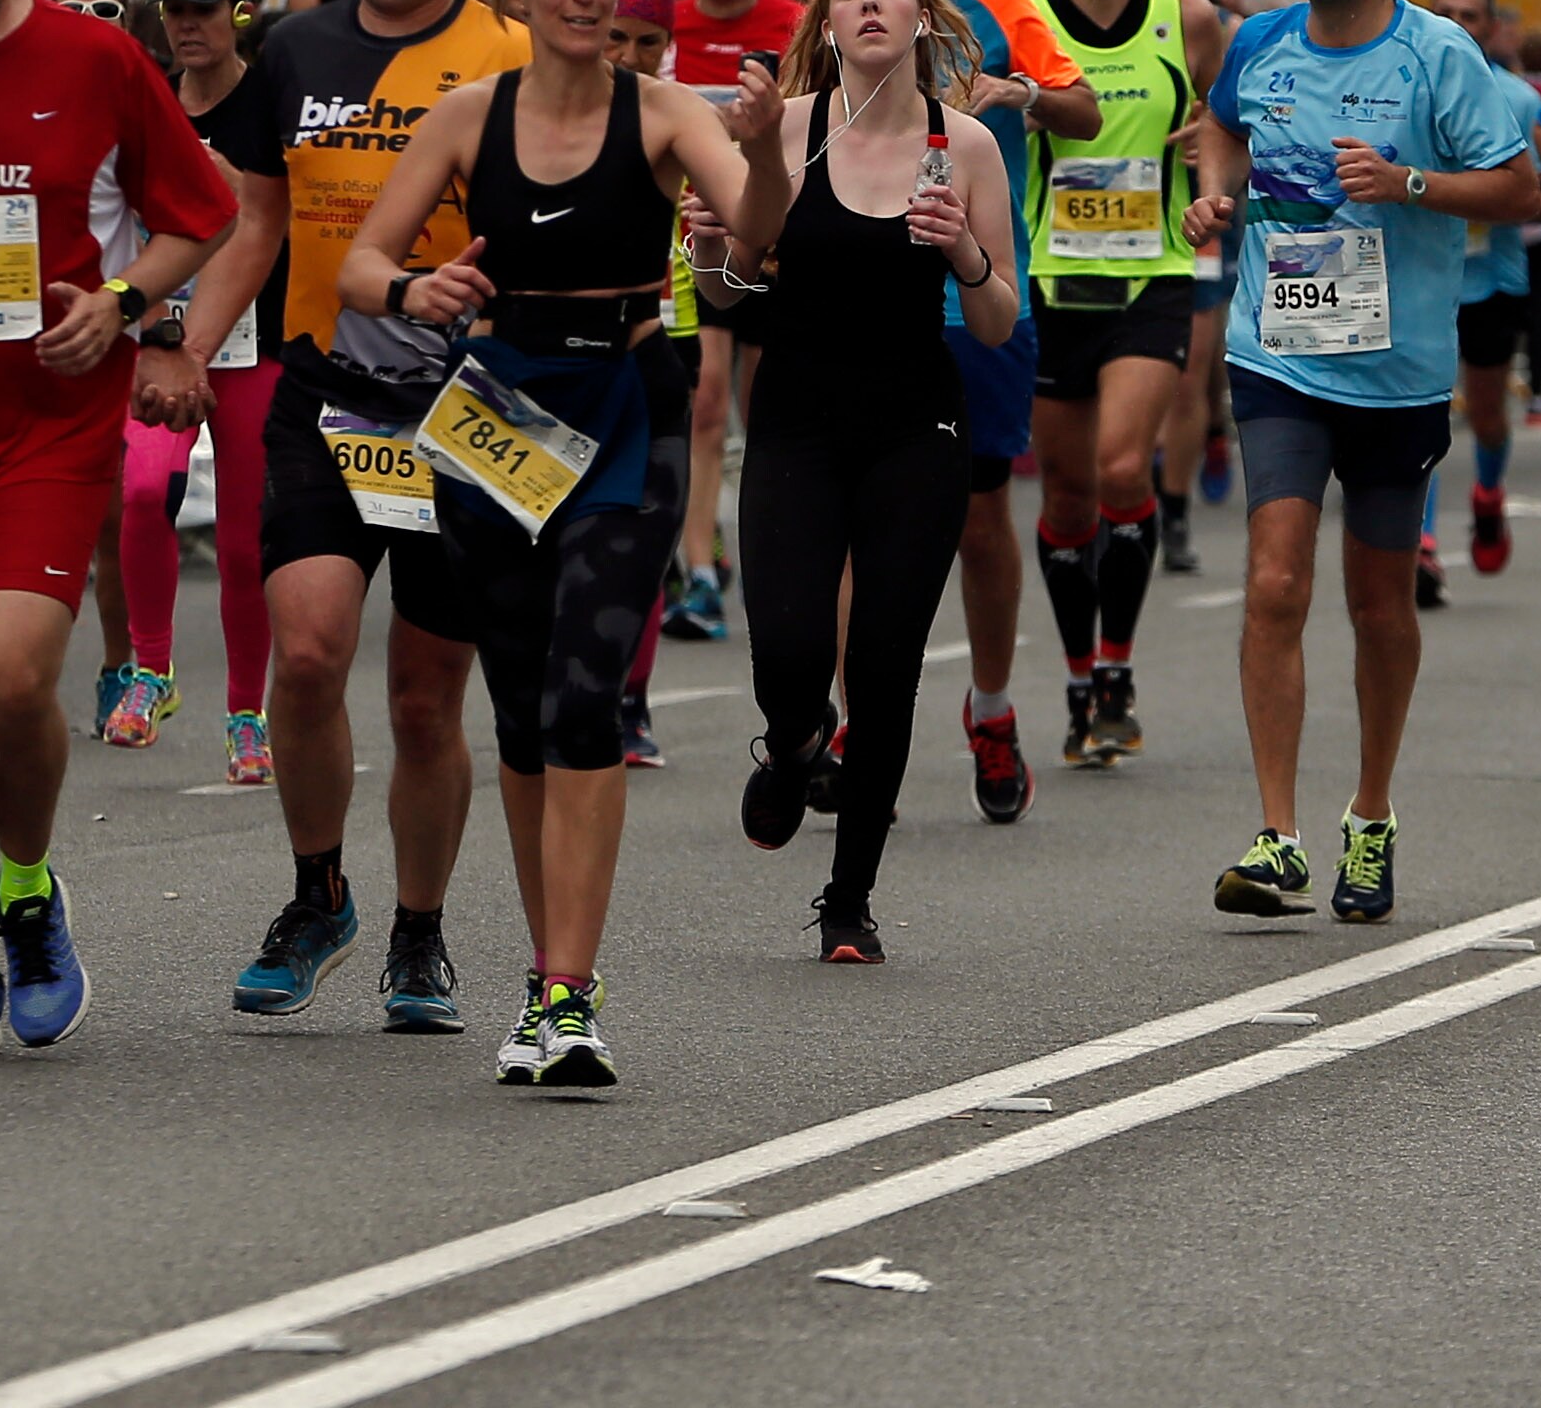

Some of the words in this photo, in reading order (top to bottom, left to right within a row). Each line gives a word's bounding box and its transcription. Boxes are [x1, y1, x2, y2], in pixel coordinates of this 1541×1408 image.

[1268, 71, 1295, 93] 24
[292, 129, 413, 153] runne
[325, 196, 374, 209] Gestore
[1067, 197, 1126, 220] 6511
[1274, 281, 1340, 310] 9594
[451, 404, 530, 476] 7841
[333, 441, 416, 479] 6005
